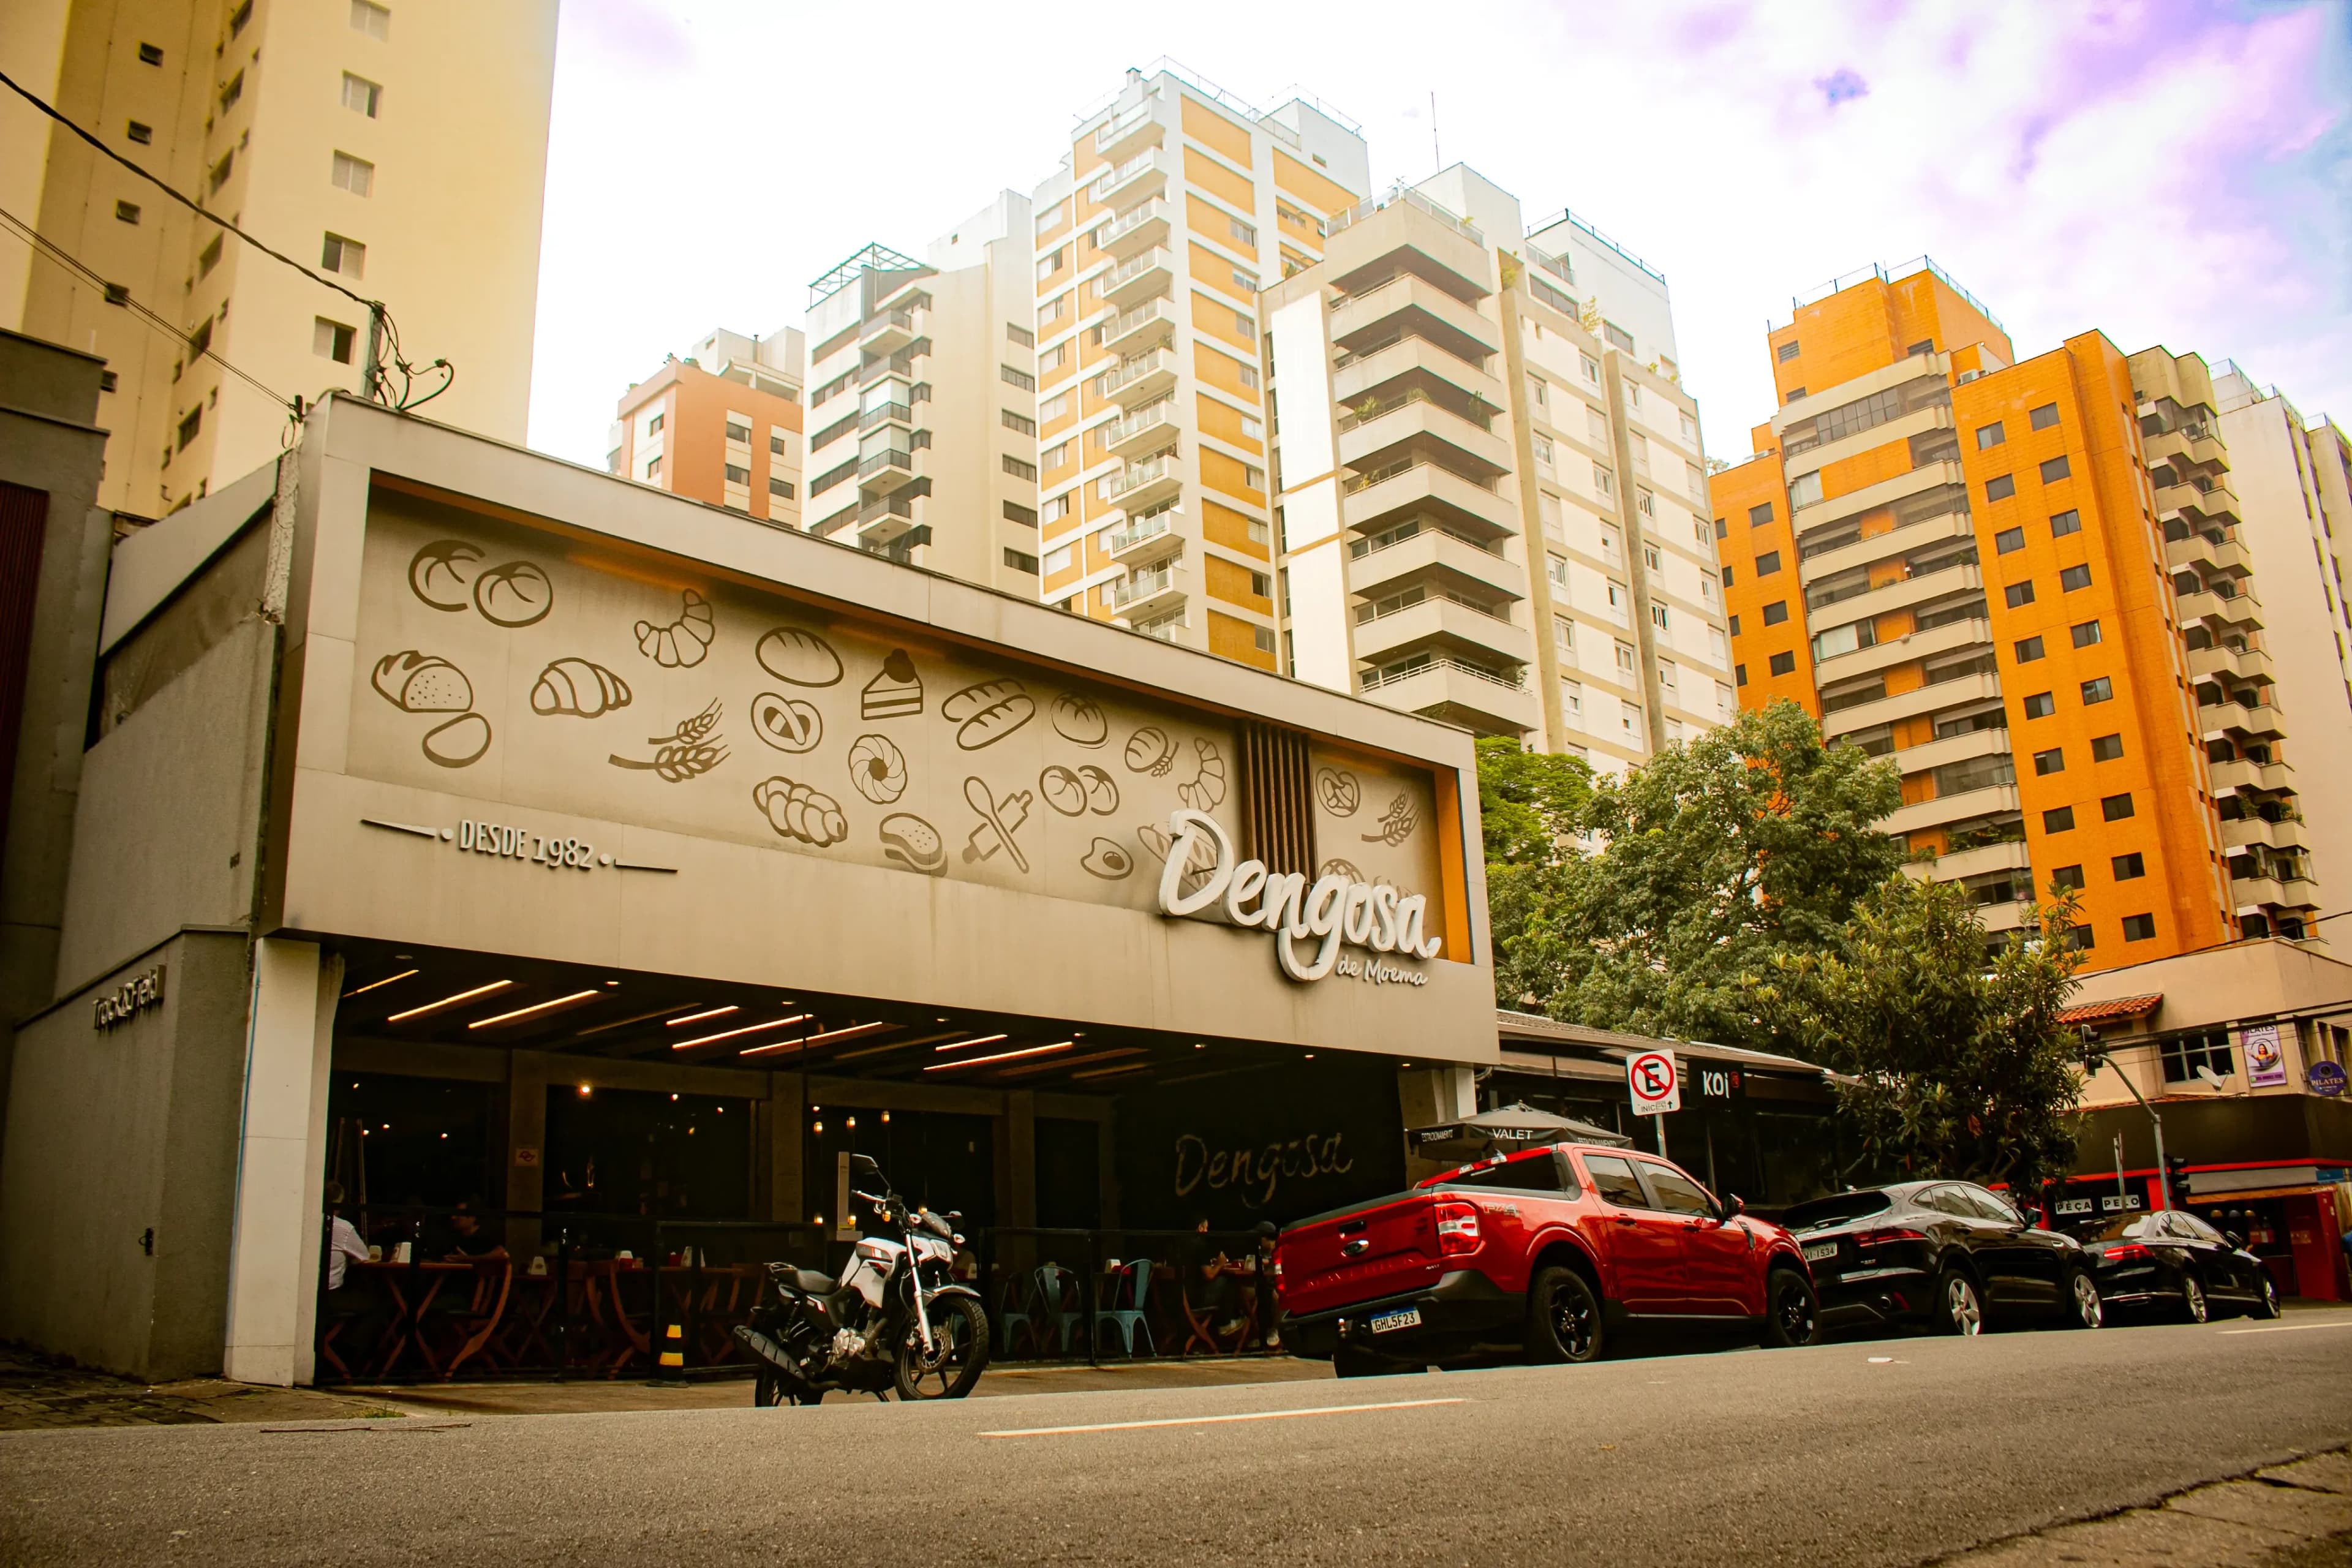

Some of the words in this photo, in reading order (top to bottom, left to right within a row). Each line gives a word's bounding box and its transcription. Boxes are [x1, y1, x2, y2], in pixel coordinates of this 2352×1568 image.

[460, 820, 527, 858] DESDE
[532, 836, 594, 868] 1982
[1159, 809, 1442, 981] Dengosa
[1337, 955, 1362, 976] de
[1364, 959, 1428, 986] Moema
[1643, 1063, 1662, 1092] E
[2311, 1077, 2343, 1086] PILATES
[1493, 1128, 1534, 1140] VALET
[1175, 1133, 1354, 1209] Dengosa
[2057, 1200, 2091, 1212] PEÇA
[2104, 1197, 2139, 1207] PEO
[1374, 1312, 1415, 1332] GHL5F23
